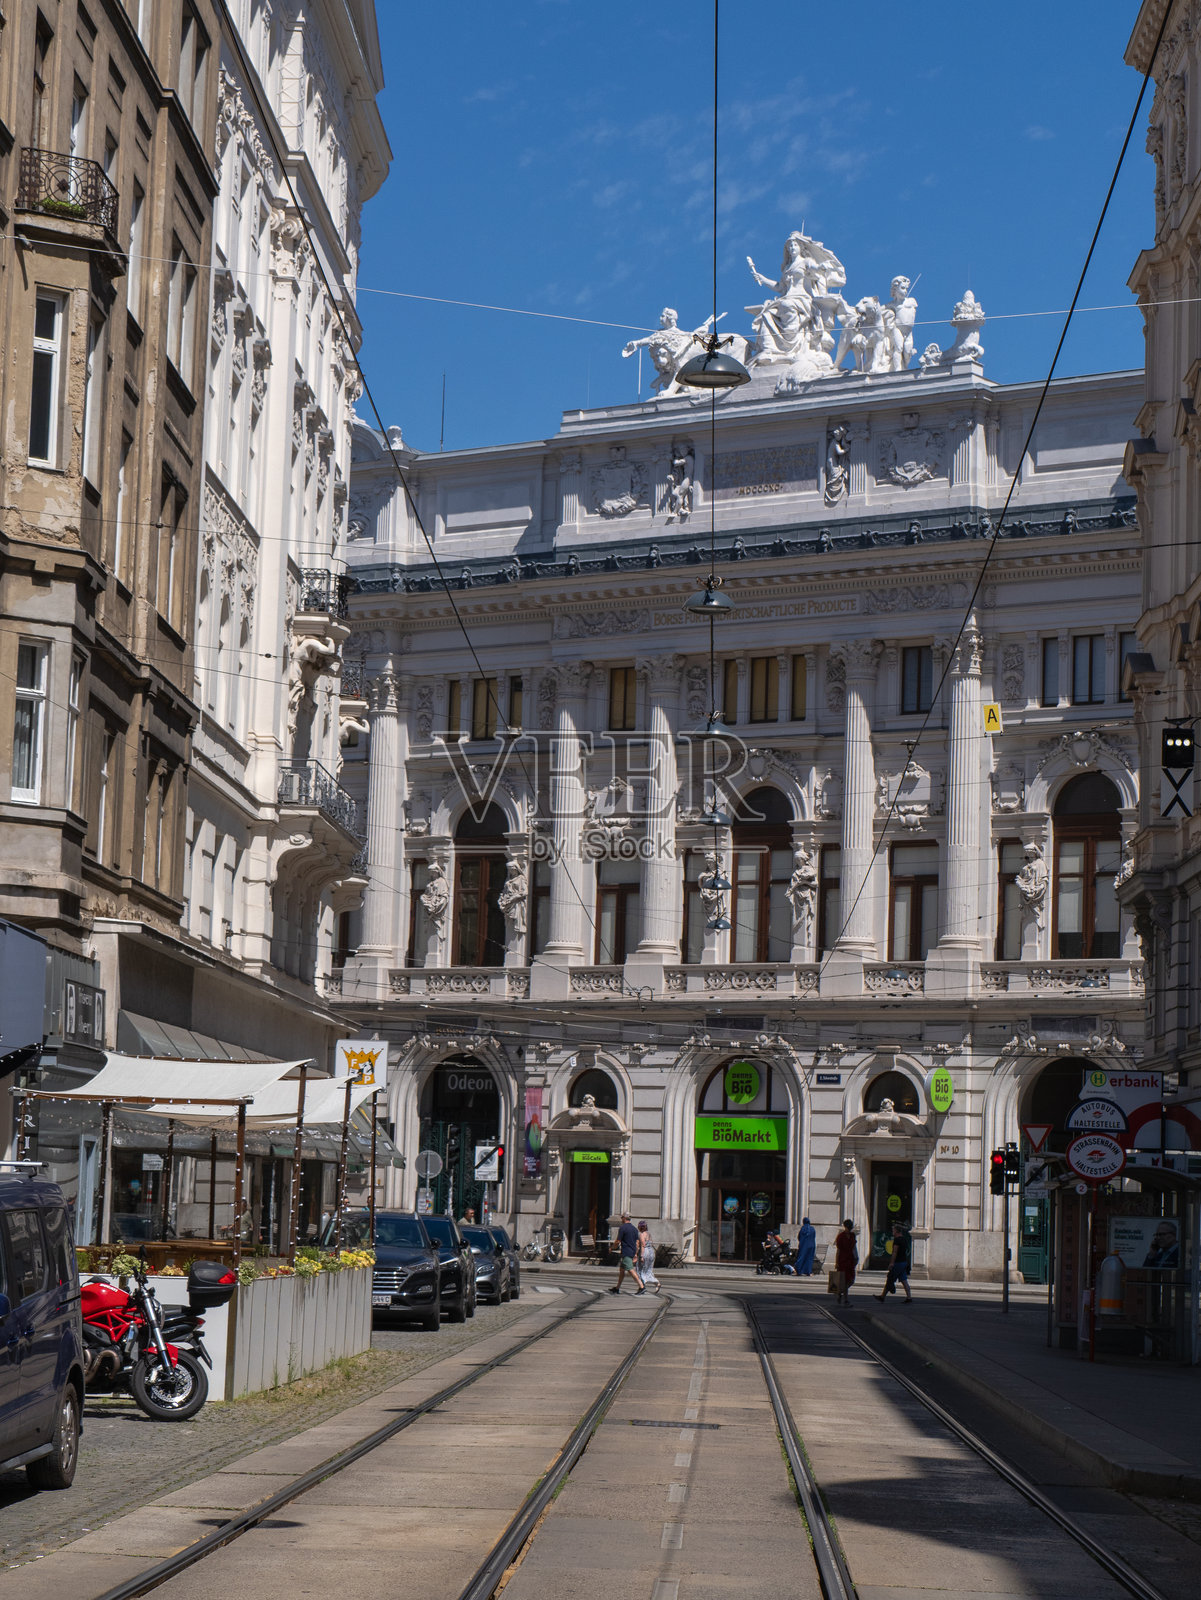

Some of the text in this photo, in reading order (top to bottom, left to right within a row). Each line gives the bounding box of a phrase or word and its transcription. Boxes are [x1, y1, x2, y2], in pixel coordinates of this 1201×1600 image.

[807, 599, 857, 615] PRODUCTE
[987, 708, 998, 724] A
[351, 1059, 358, 1067] F
[364, 1076, 371, 1084] P
[448, 1074, 493, 1090] Odeon
[1094, 1074, 1103, 1084] H
[1109, 1074, 1159, 1088] erbank
[1081, 1102, 1116, 1115] AUTOBUS
[1073, 1120, 1121, 1129] HALTESTELLE
[952, 1145, 959, 1155] 10
[1073, 1137, 1121, 1155] STRASSENBAHN
[1075, 1160, 1118, 1176] HALTESTELLE
